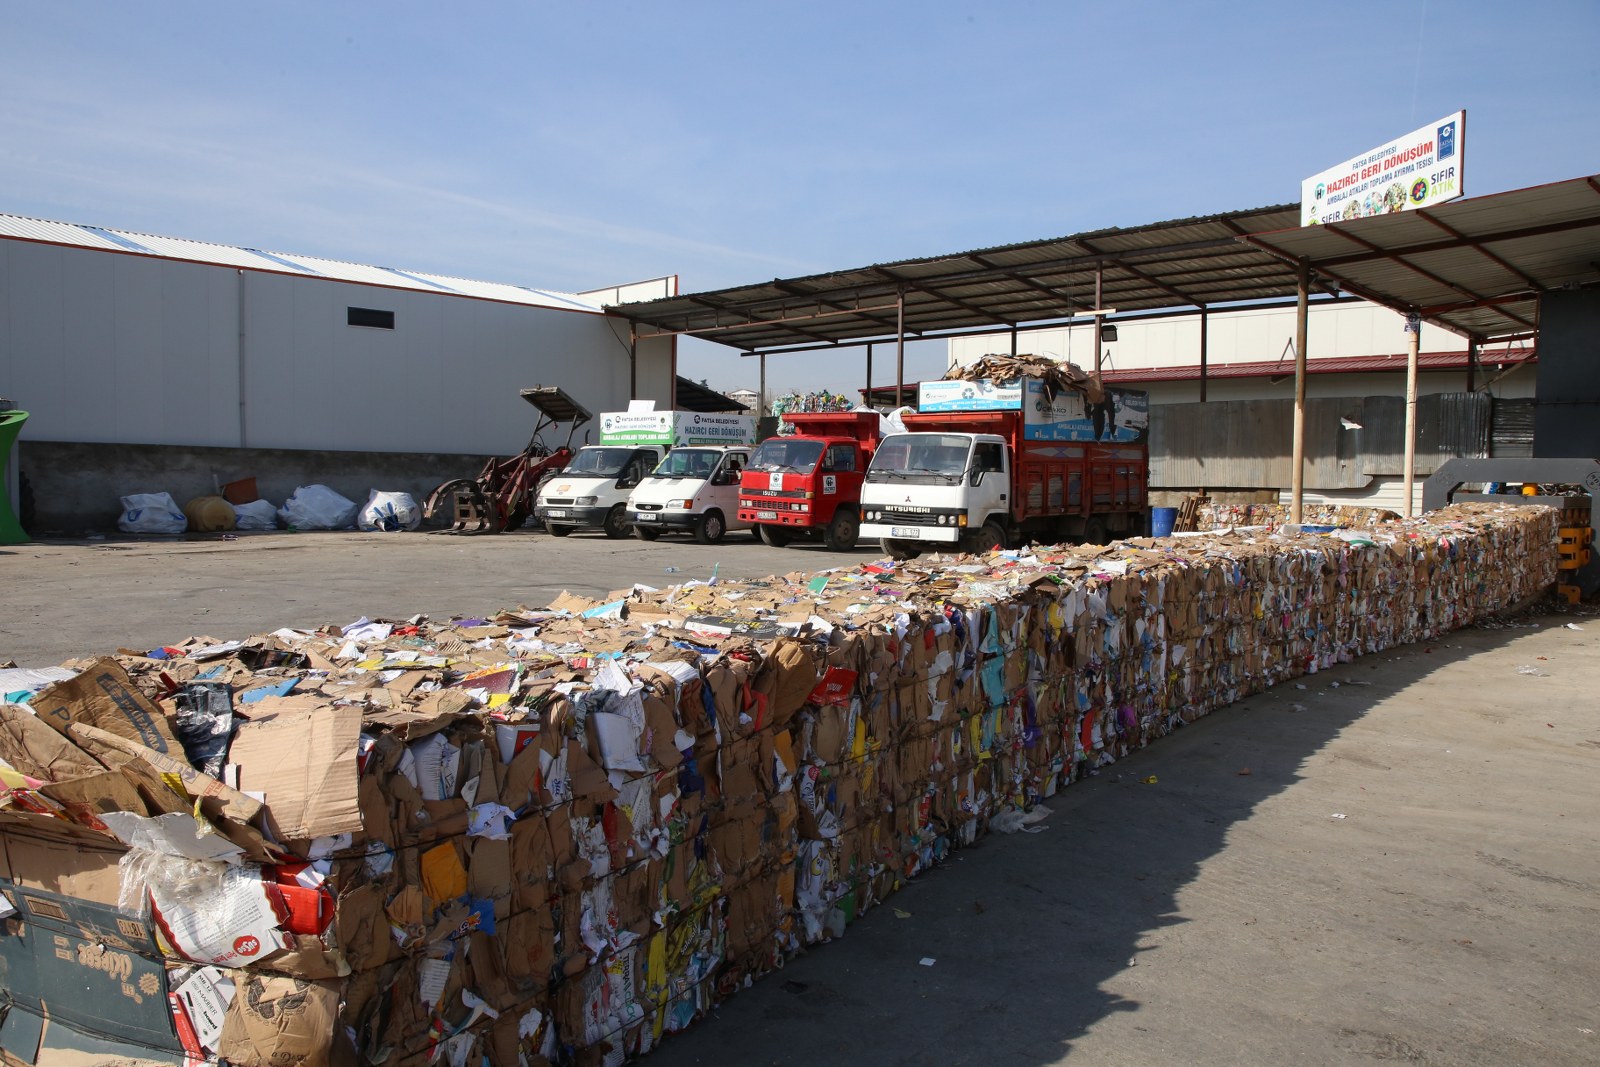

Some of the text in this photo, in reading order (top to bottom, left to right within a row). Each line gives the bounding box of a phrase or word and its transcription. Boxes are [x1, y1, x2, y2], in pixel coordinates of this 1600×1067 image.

[1352, 145, 1397, 170] FATSA BELEDİYESİ
[1326, 141, 1433, 194] HAZIRCI GERİ DÖNÜŞÜM
[1431, 166, 1455, 185] SIFIR
[1327, 157, 1434, 205] AMBALAJ ATIKLARI TOPLAMA AYIRMA TESİSİ
[1430, 178, 1455, 197] ATIK
[1321, 210, 1341, 225] SIFIR
[684, 425, 747, 438] HAZIRCI GERİ DÖNÜŞÜM
[885, 505, 931, 513] MITSUBISHI
